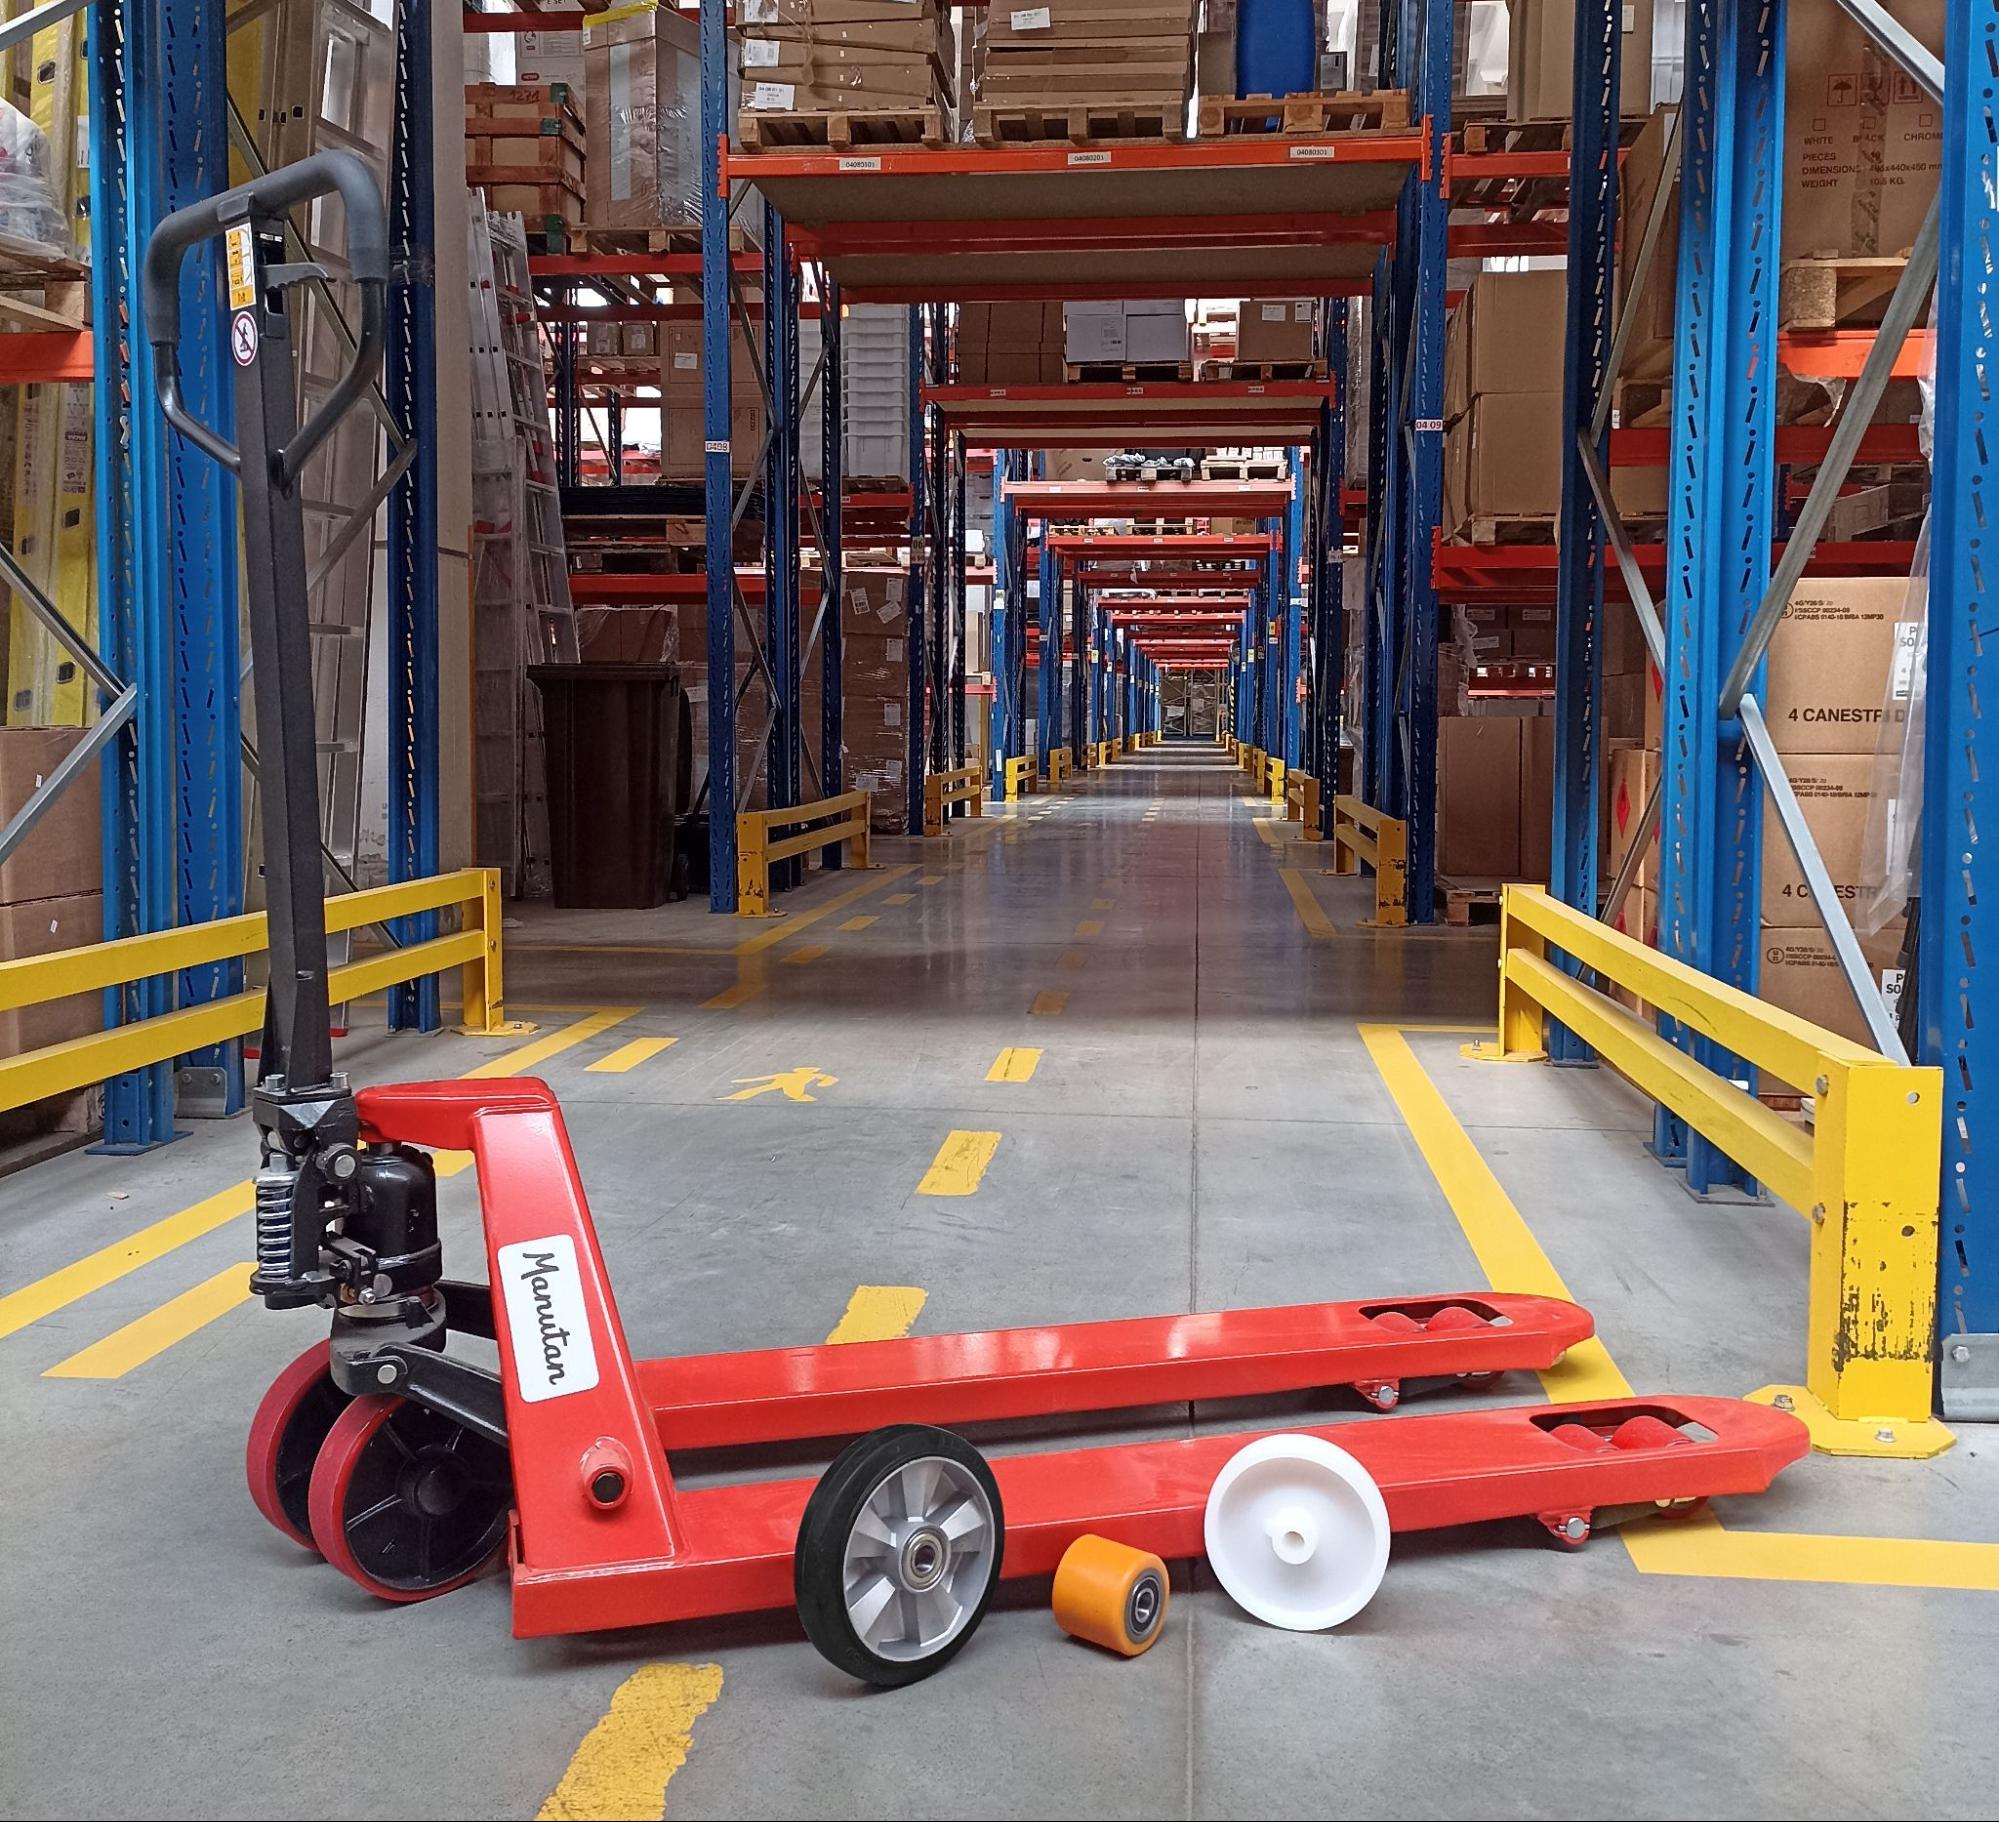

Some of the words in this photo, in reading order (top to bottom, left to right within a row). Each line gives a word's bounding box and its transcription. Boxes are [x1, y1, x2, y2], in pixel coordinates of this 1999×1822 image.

[1804, 136, 1833, 145] WHITE
[1802, 152, 1837, 161] PIECES
[1801, 179, 1838, 188] WEIGHT
[1416, 421, 1427, 429] 04
[1788, 708, 1798, 721] 4
[1782, 884, 1792, 897] 4
[521, 1253, 570, 1385] Manutan
